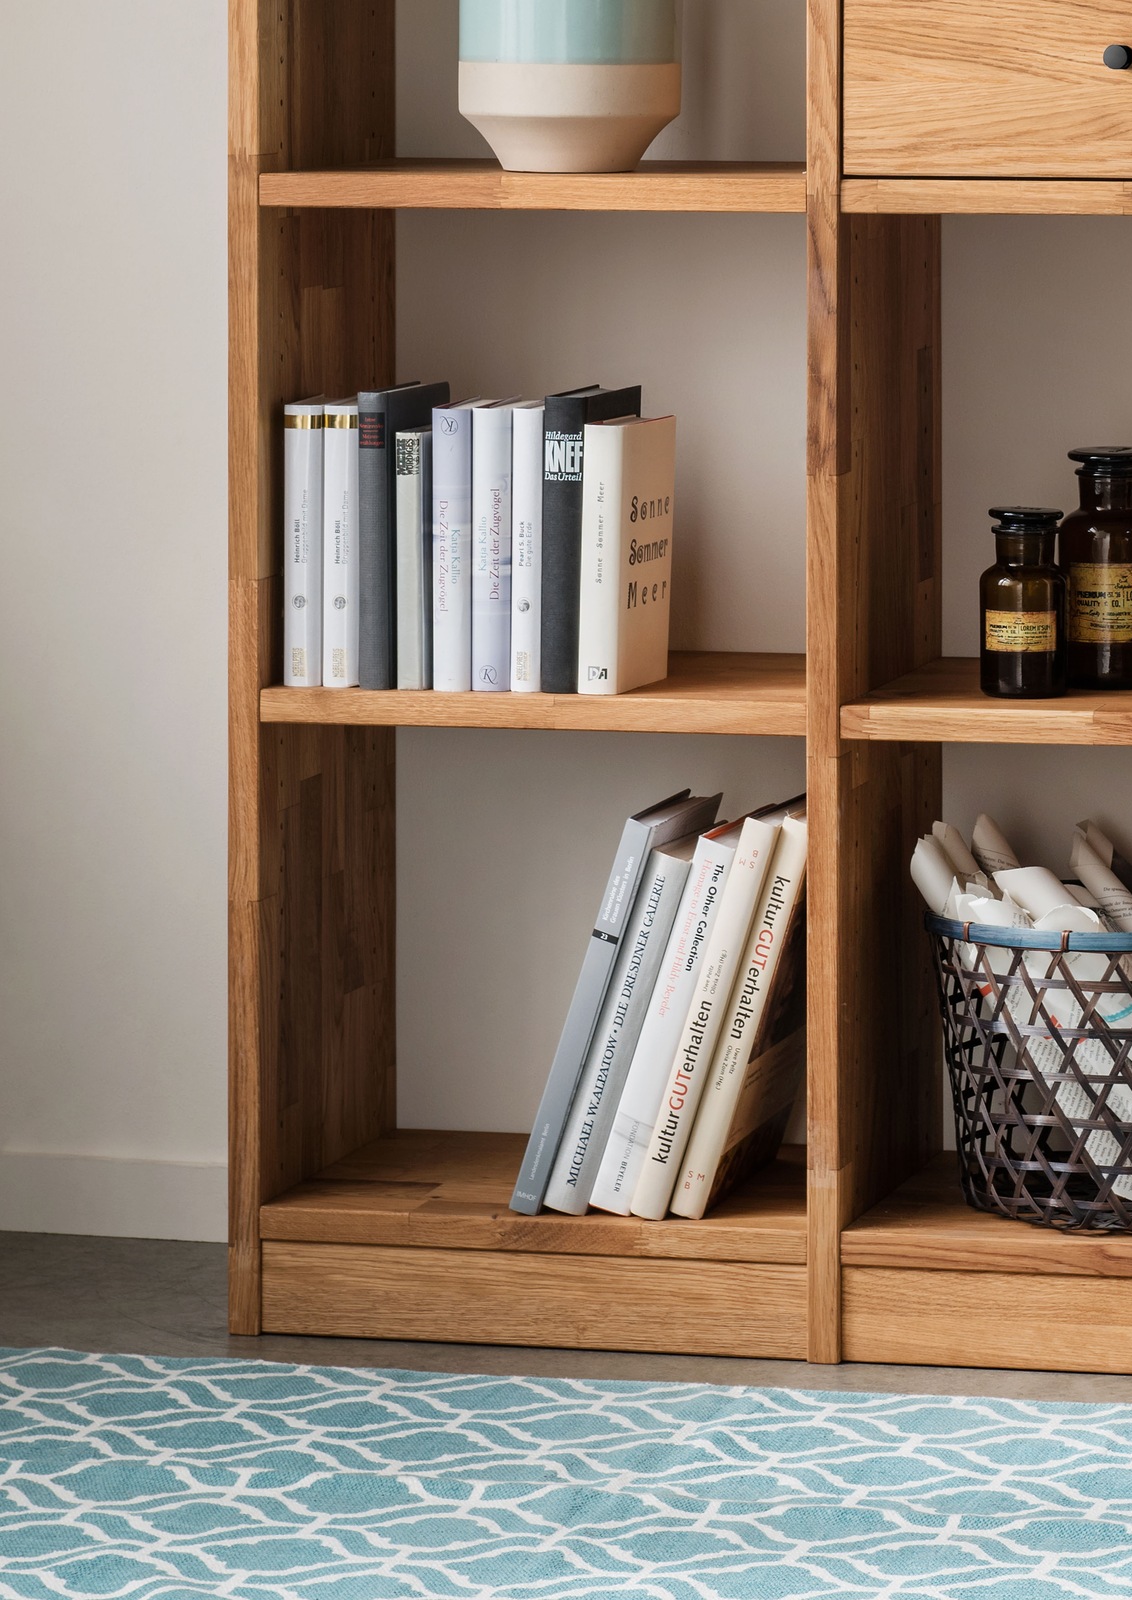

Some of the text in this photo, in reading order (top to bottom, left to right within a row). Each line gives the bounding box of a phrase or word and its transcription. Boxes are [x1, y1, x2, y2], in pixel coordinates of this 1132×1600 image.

[545, 431, 582, 442] Hildegard
[545, 441, 584, 473] KNEF
[544, 472, 583, 482] Das Urteil
[630, 495, 670, 523] Sonne
[437, 500, 449, 613] Die Zeit der Zugvögel
[451, 528, 461, 585] Katja Kallio
[478, 516, 488, 572] Katja Kallio
[489, 488, 502, 601] Die Zeit der Zugvögel
[629, 538, 668, 566] Sommer
[627, 579, 667, 609] Meer
[643, 873, 667, 929] GALERIE
[692, 858, 713, 898] Homage
[684, 863, 726, 973] The Other Collection
[690, 898, 699, 911] to
[620, 929, 650, 1001] DRESDNER
[730, 875, 791, 1041] kulturGUTerhalten
[612, 1000, 629, 1029] DIE
[651, 1000, 713, 1165] kulturGUTerhalten
[565, 1119, 595, 1188] MICHAEL
[613, 1160, 629, 1193] BEYELER
